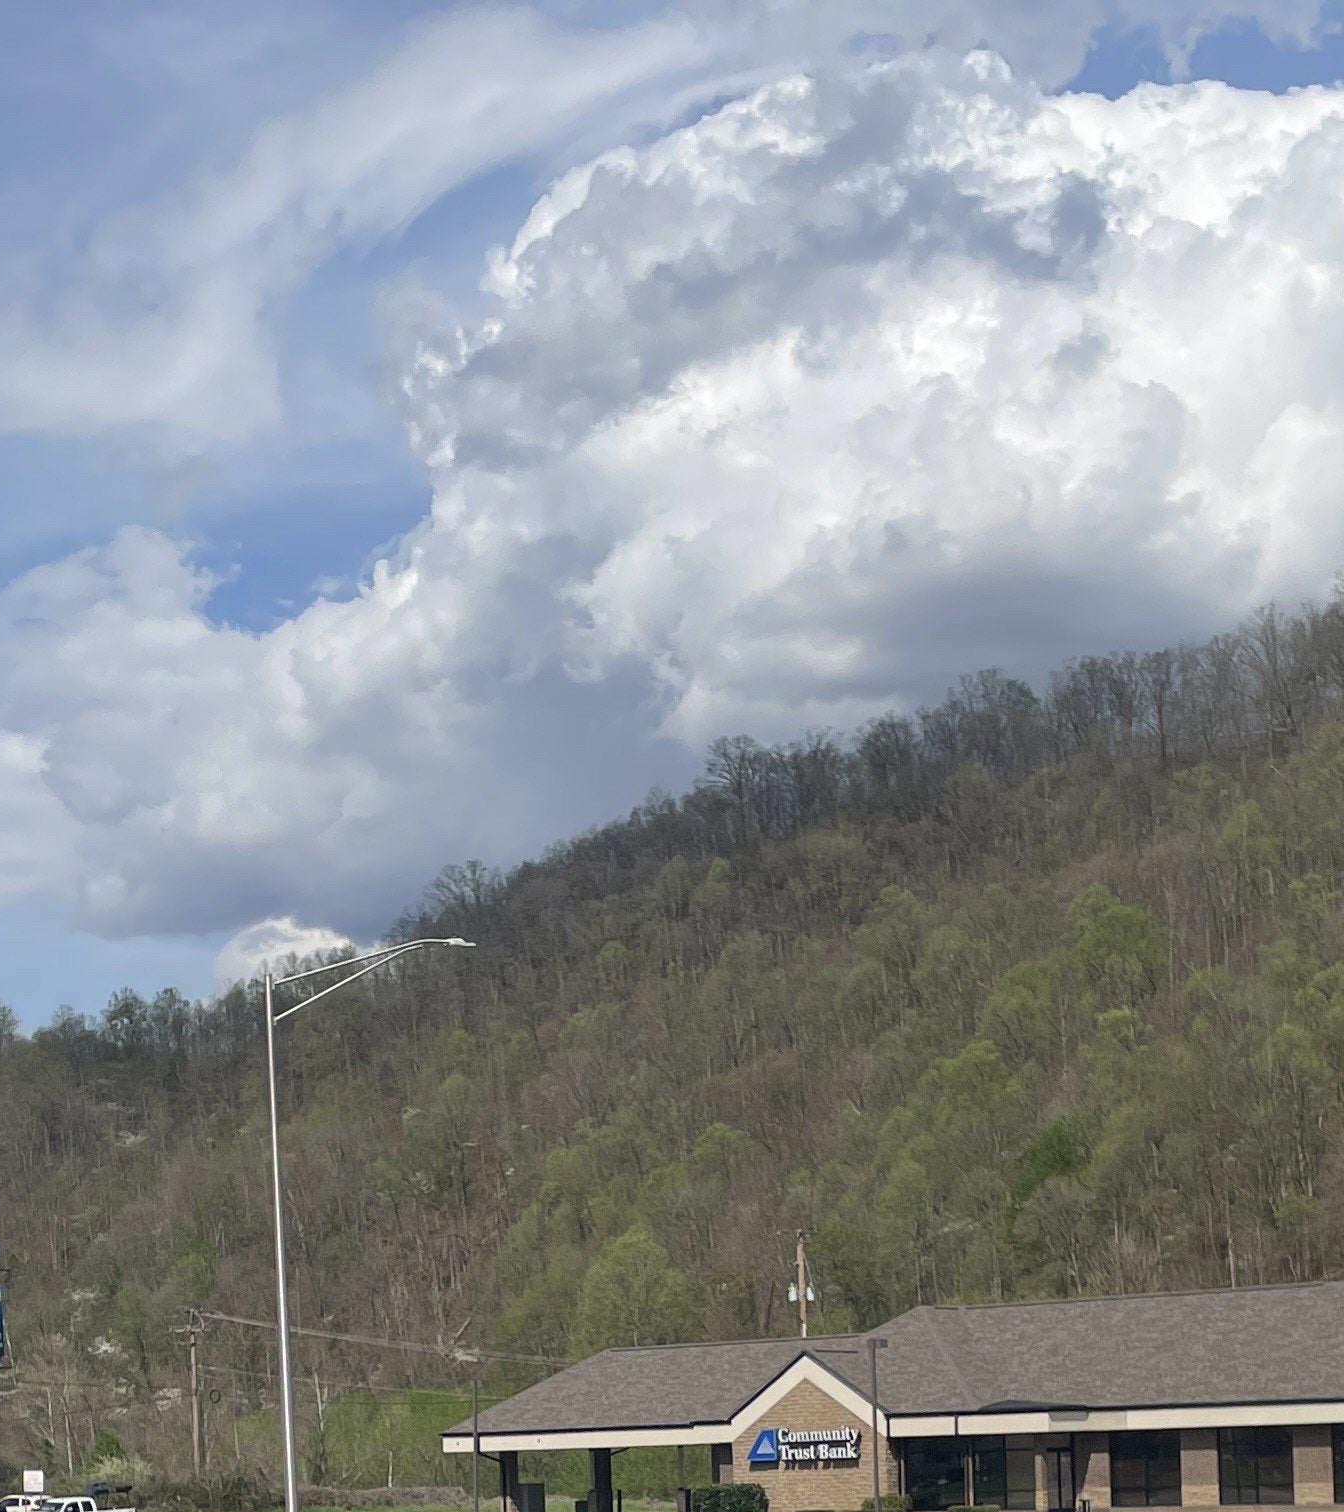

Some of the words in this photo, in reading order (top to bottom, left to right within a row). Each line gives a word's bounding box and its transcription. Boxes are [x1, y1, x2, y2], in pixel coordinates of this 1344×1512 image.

[777, 1425, 860, 1444] Community
[777, 1445, 816, 1460] Trust
[818, 1442, 859, 1460] Bank
